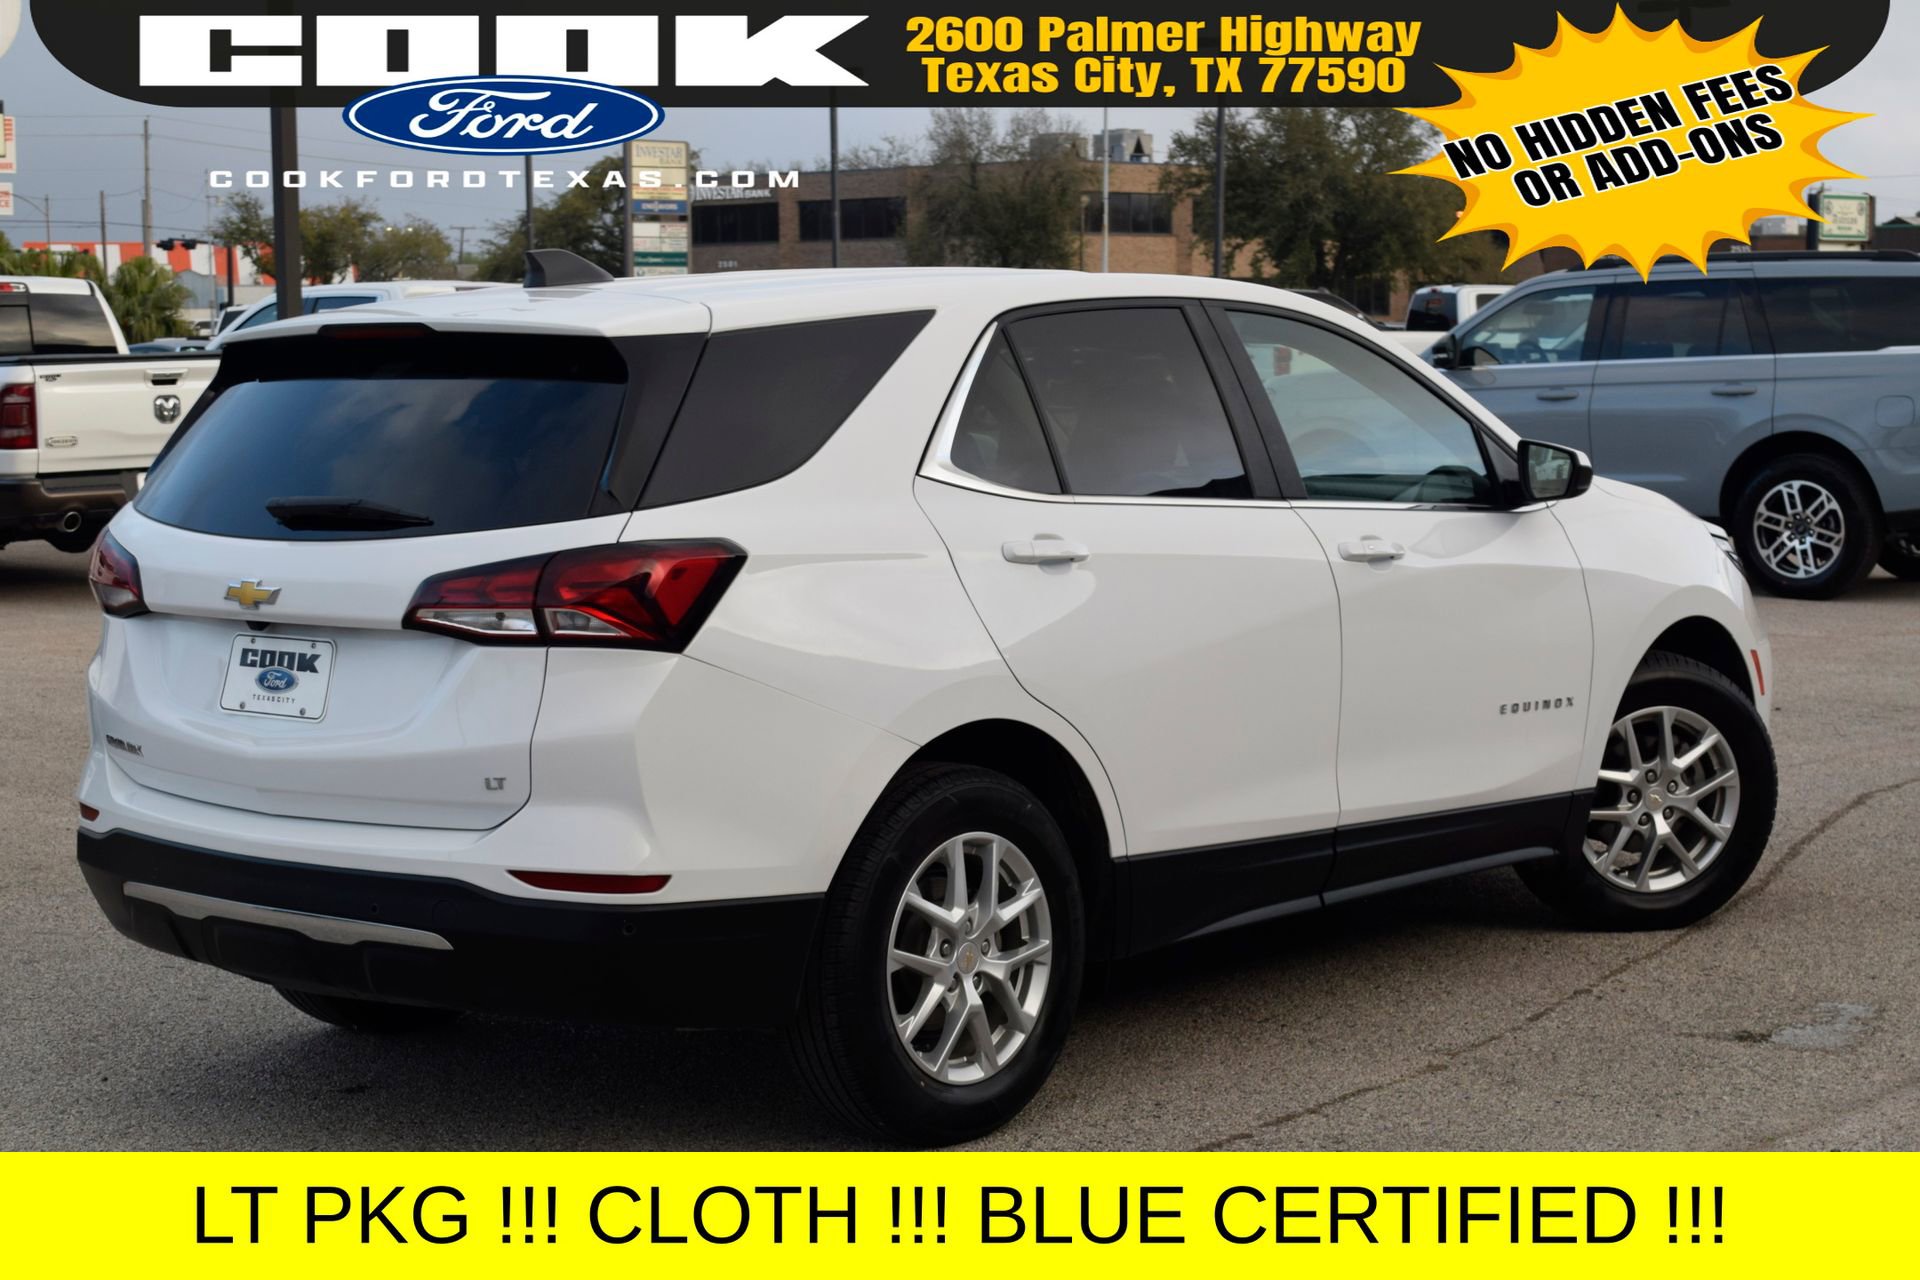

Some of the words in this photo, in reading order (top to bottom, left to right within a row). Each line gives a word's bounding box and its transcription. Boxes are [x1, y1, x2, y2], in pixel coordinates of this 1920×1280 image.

[240, 647, 322, 674] COOK
[263, 671, 288, 689] Ford
[1499, 696, 1575, 715] EQUINOX
[484, 776, 507, 791] LT
